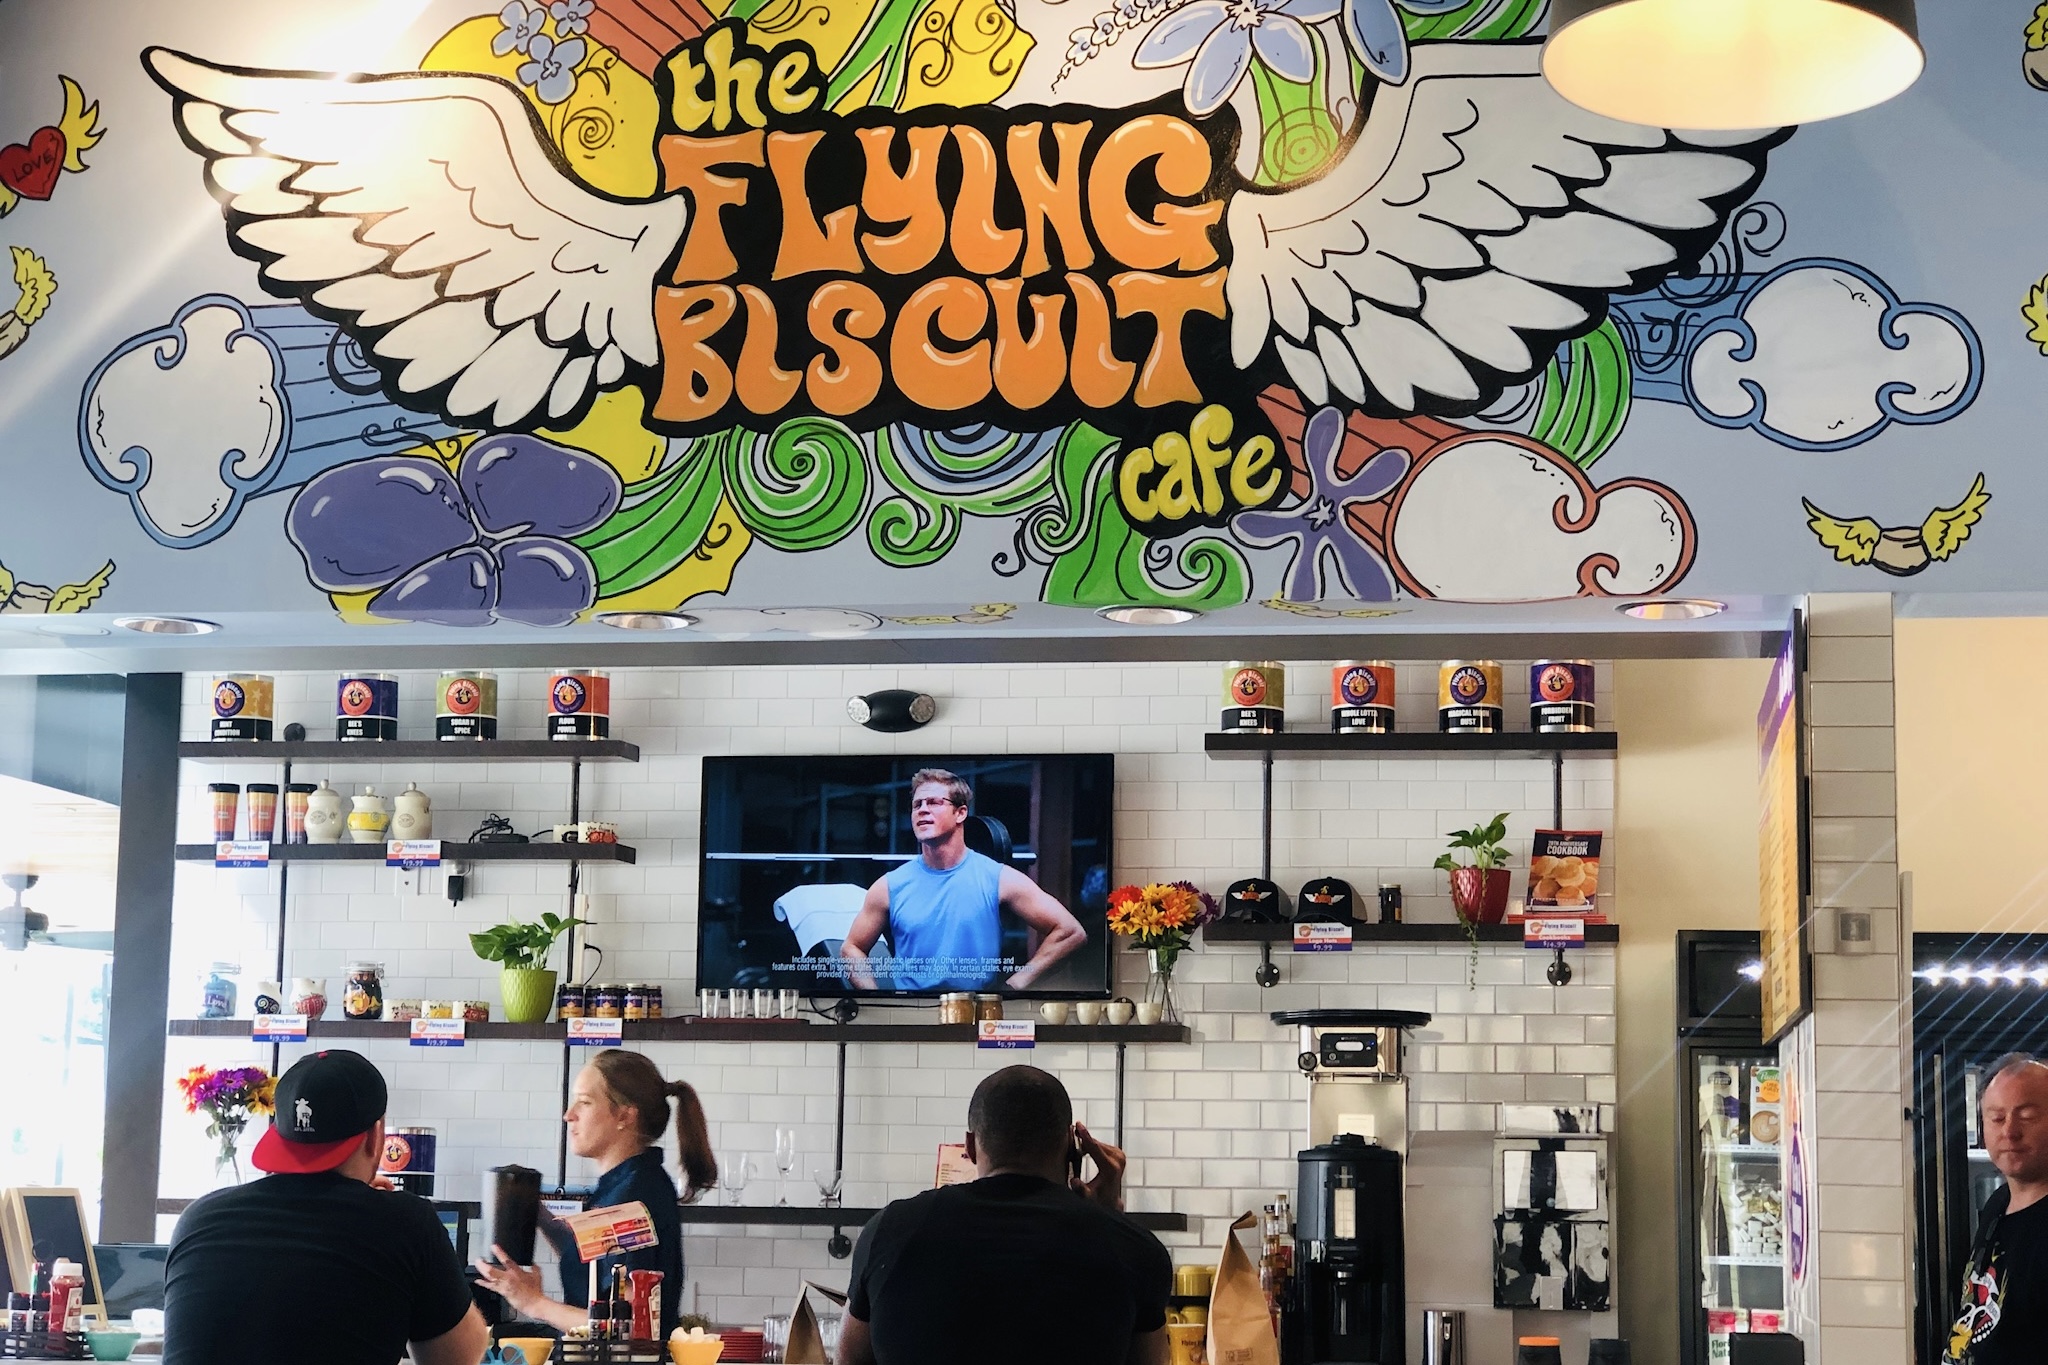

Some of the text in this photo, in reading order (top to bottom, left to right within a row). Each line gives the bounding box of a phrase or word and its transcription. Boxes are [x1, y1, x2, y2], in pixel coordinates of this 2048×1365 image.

[667, 26, 819, 132] the
[12, 148, 54, 183] LOVE
[659, 113, 1225, 281] FLYING
[653, 267, 1227, 421] BISCUIT
[1119, 404, 1282, 520] cafe
[1541, 707, 1572, 715] FORBIDDEN
[1546, 846, 1588, 855] COOKBOOK
[772, 962, 796, 970] features
[982, 964, 1002, 973] states,
[818, 956, 856, 966] single-vision
[884, 956, 904, 966] plastic
[981, 956, 1002, 964] frames
[816, 970, 842, 980] provided
[844, 970, 851, 979] by
[852, 970, 888, 980] independent
[889, 971, 926, 980] optometrists
